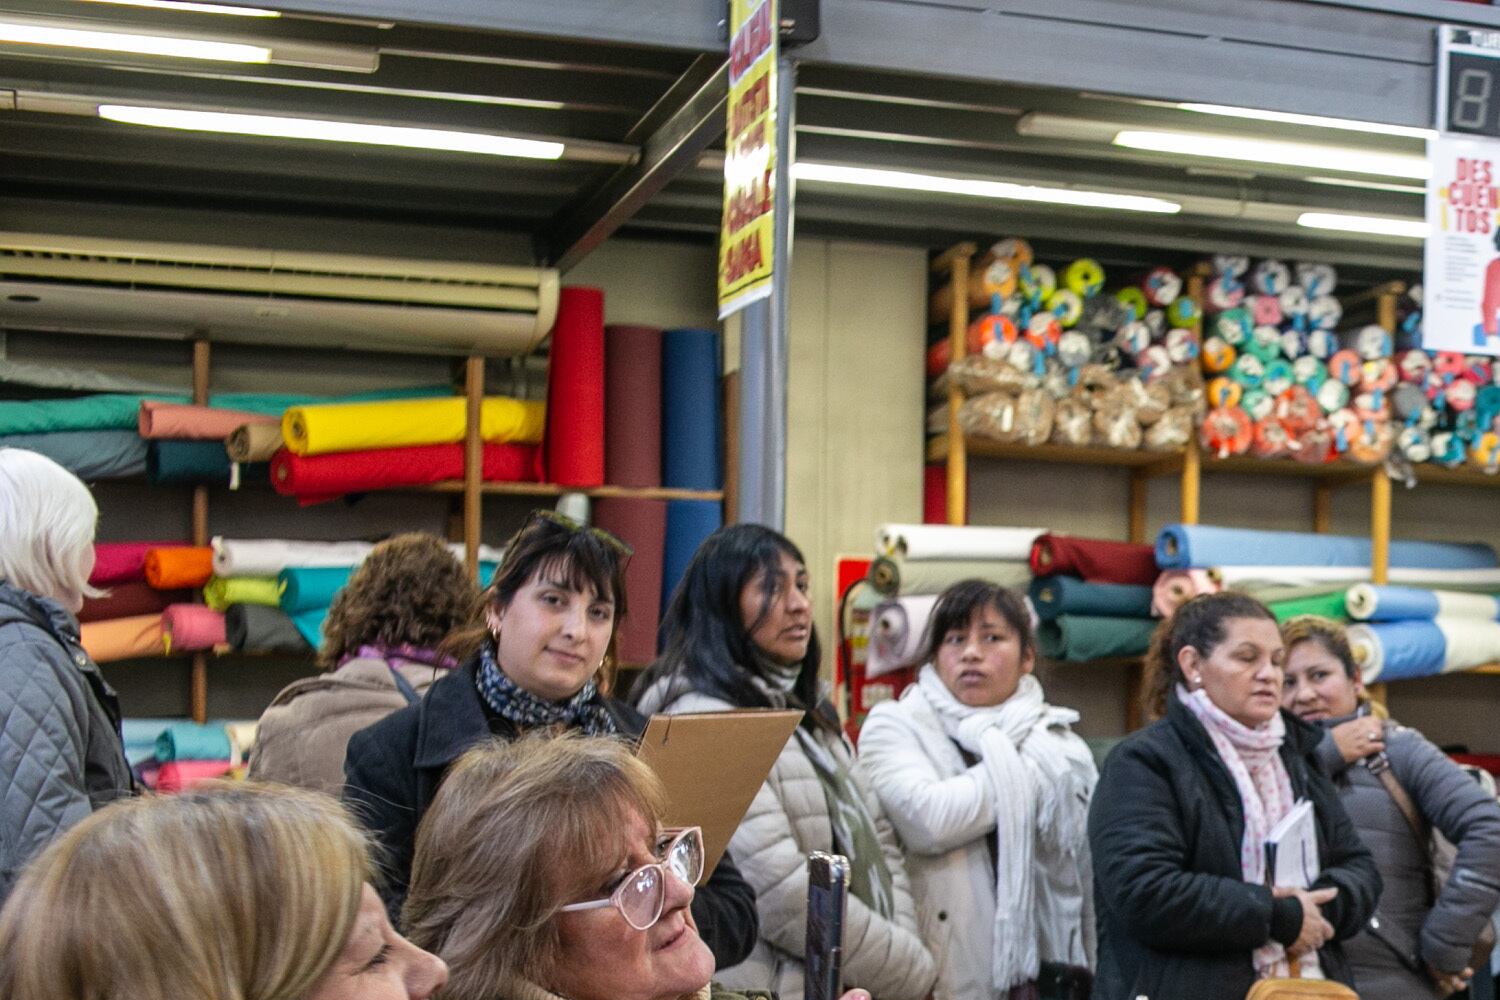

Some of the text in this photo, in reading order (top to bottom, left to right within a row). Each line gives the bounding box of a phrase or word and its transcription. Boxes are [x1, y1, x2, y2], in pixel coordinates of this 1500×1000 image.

[1456, 157, 1492, 185] DES
[1448, 181, 1499, 210] CUEN
[1455, 208, 1490, 235] TOS
